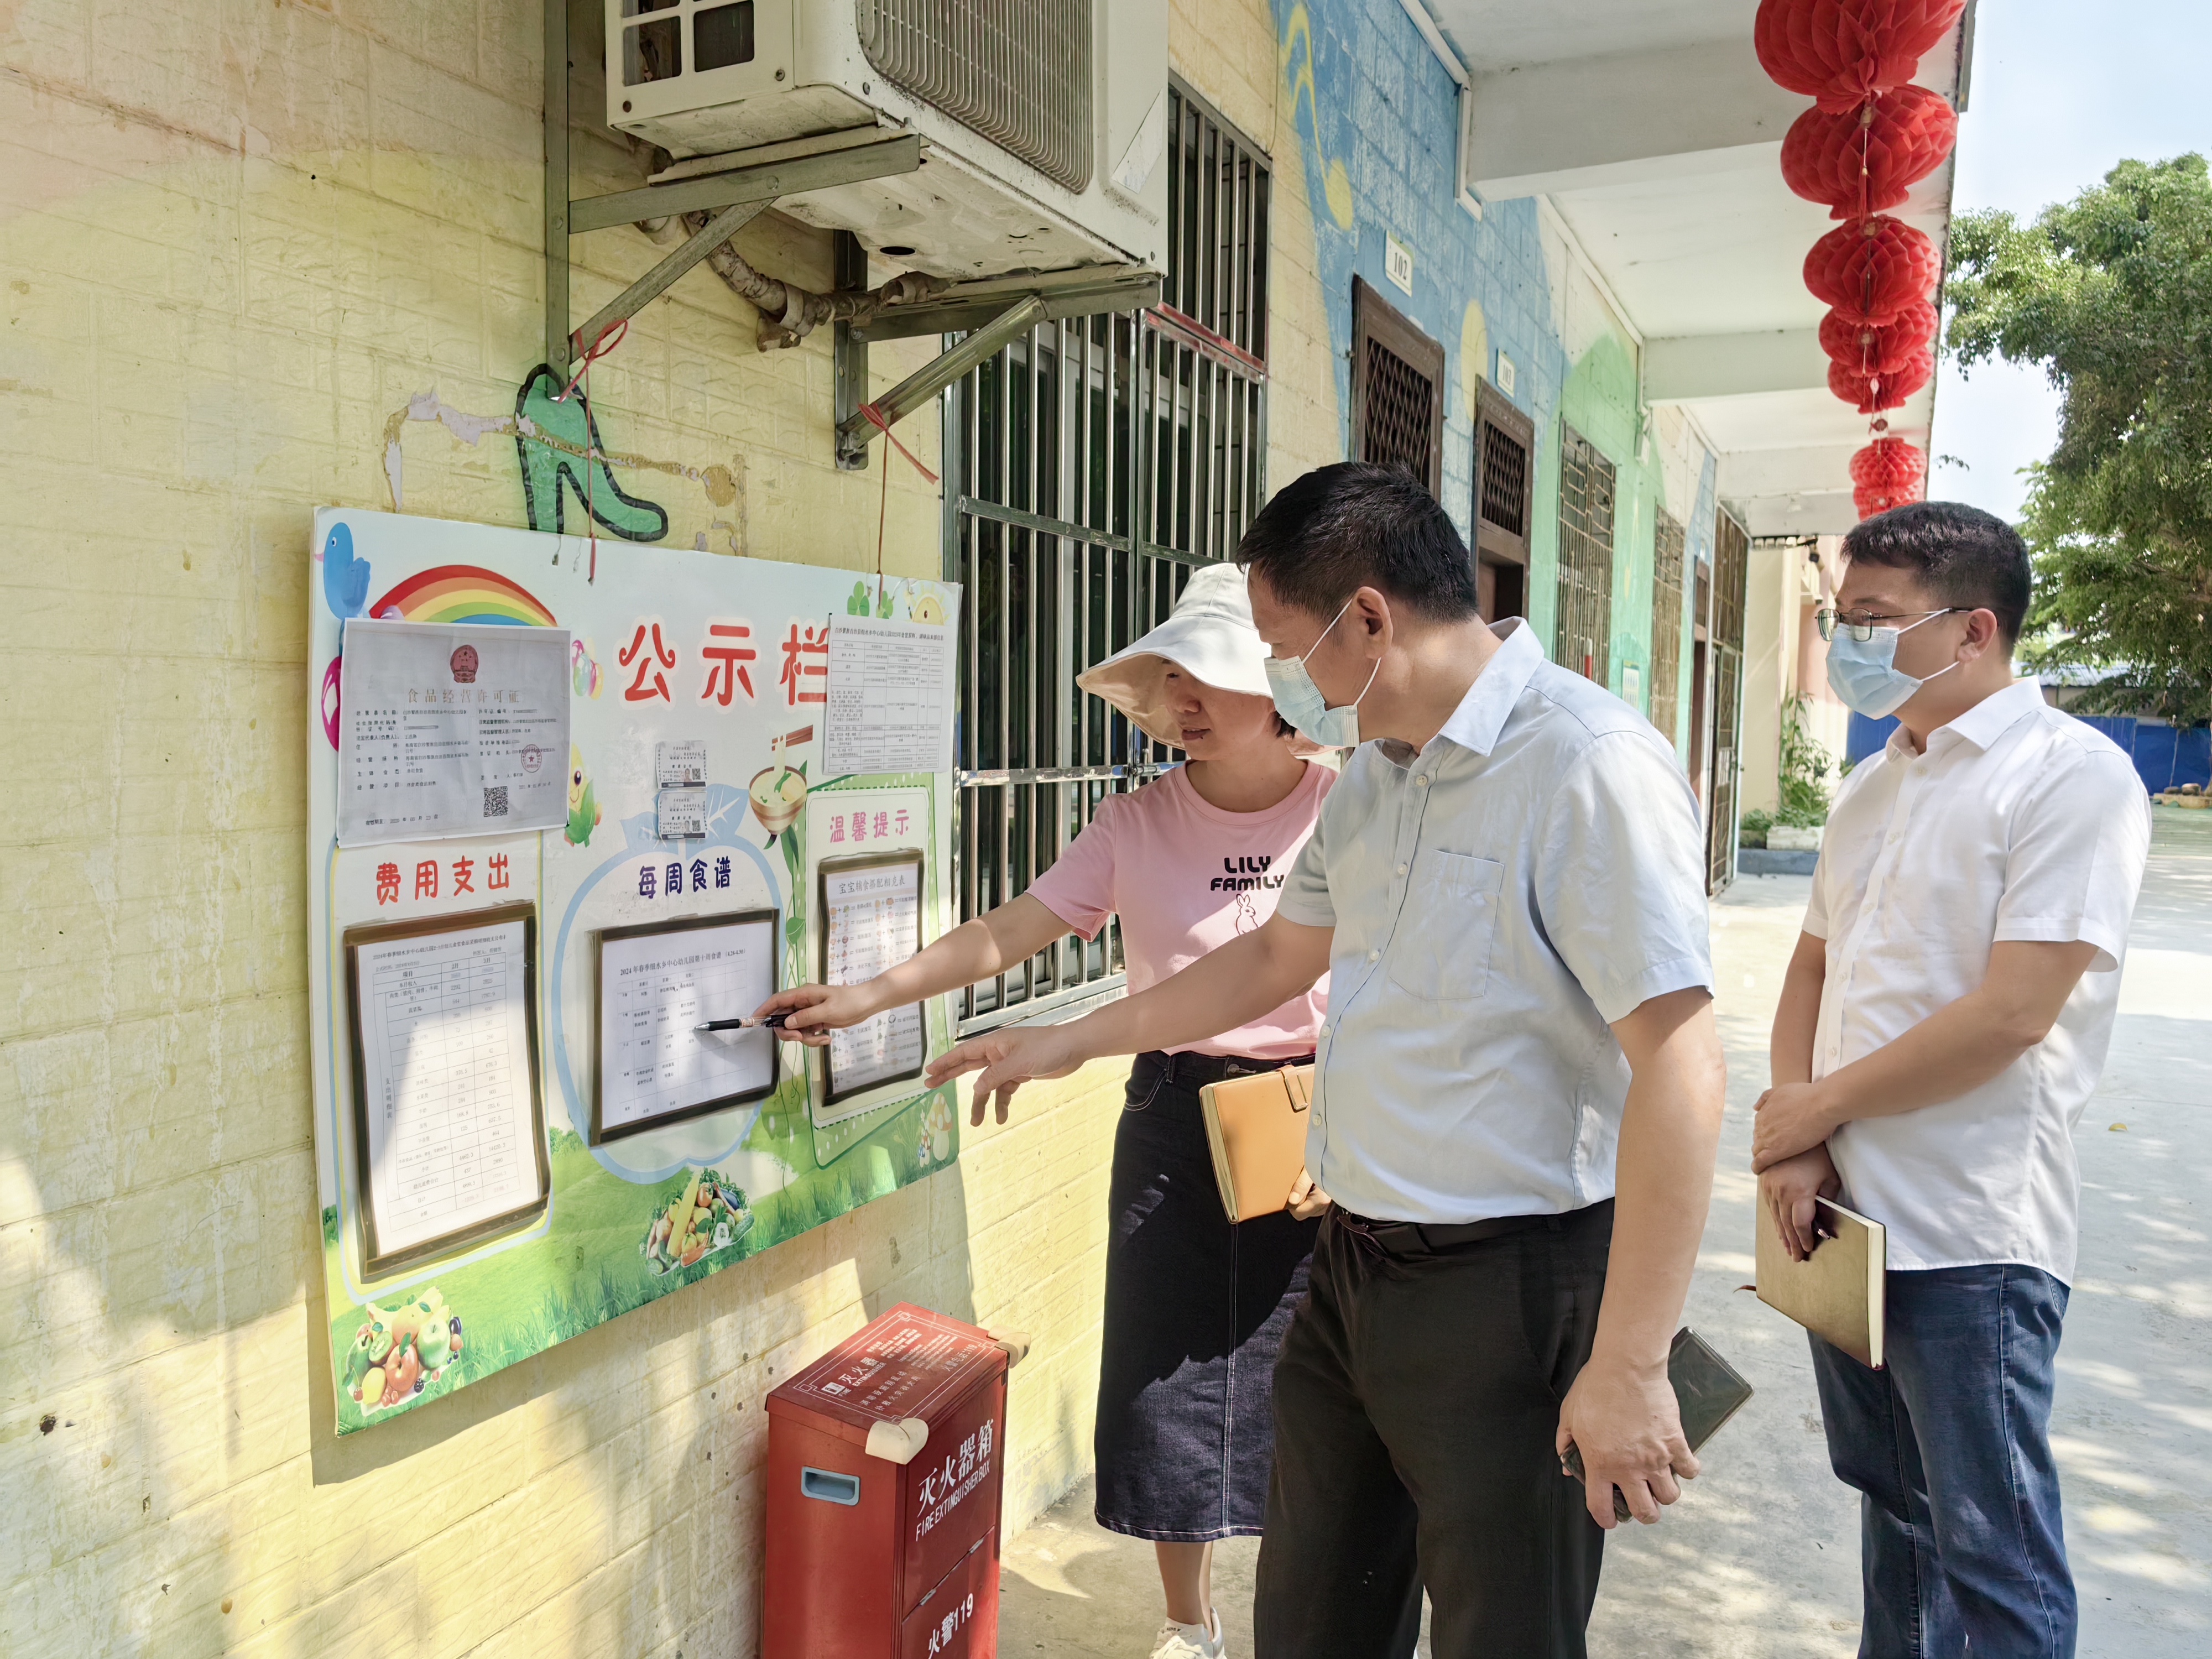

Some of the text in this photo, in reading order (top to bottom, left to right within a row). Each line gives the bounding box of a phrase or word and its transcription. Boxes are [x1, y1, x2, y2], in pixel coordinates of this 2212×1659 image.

[1394, 252, 1407, 280] 102
[619, 623, 828, 706] 公示栏
[409, 688, 519, 703] 食品经营许可证
[830, 809, 909, 843] 温馨提示
[638, 856, 731, 899] 每周食谱
[1224, 855, 1271, 874] LILY
[376, 853, 509, 905] 费用支出
[839, 875, 905, 894] 宝宝辅食搭配相克表
[1210, 874, 1285, 891] FAMILY
[620, 967, 632, 975] 2024
[459, 1152, 474, 1161] 4462.3
[489, 1142, 506, 1152] 14420.3
[838, 1357, 879, 1384] 灭火器
[852, 1362, 887, 1387] EXTINGUISHER
[917, 1419, 994, 1519] 灭火器箱
[916, 1459, 990, 1542] FIRE EXTINGUISHER BOX
[928, 1593, 973, 1659] 火警119
